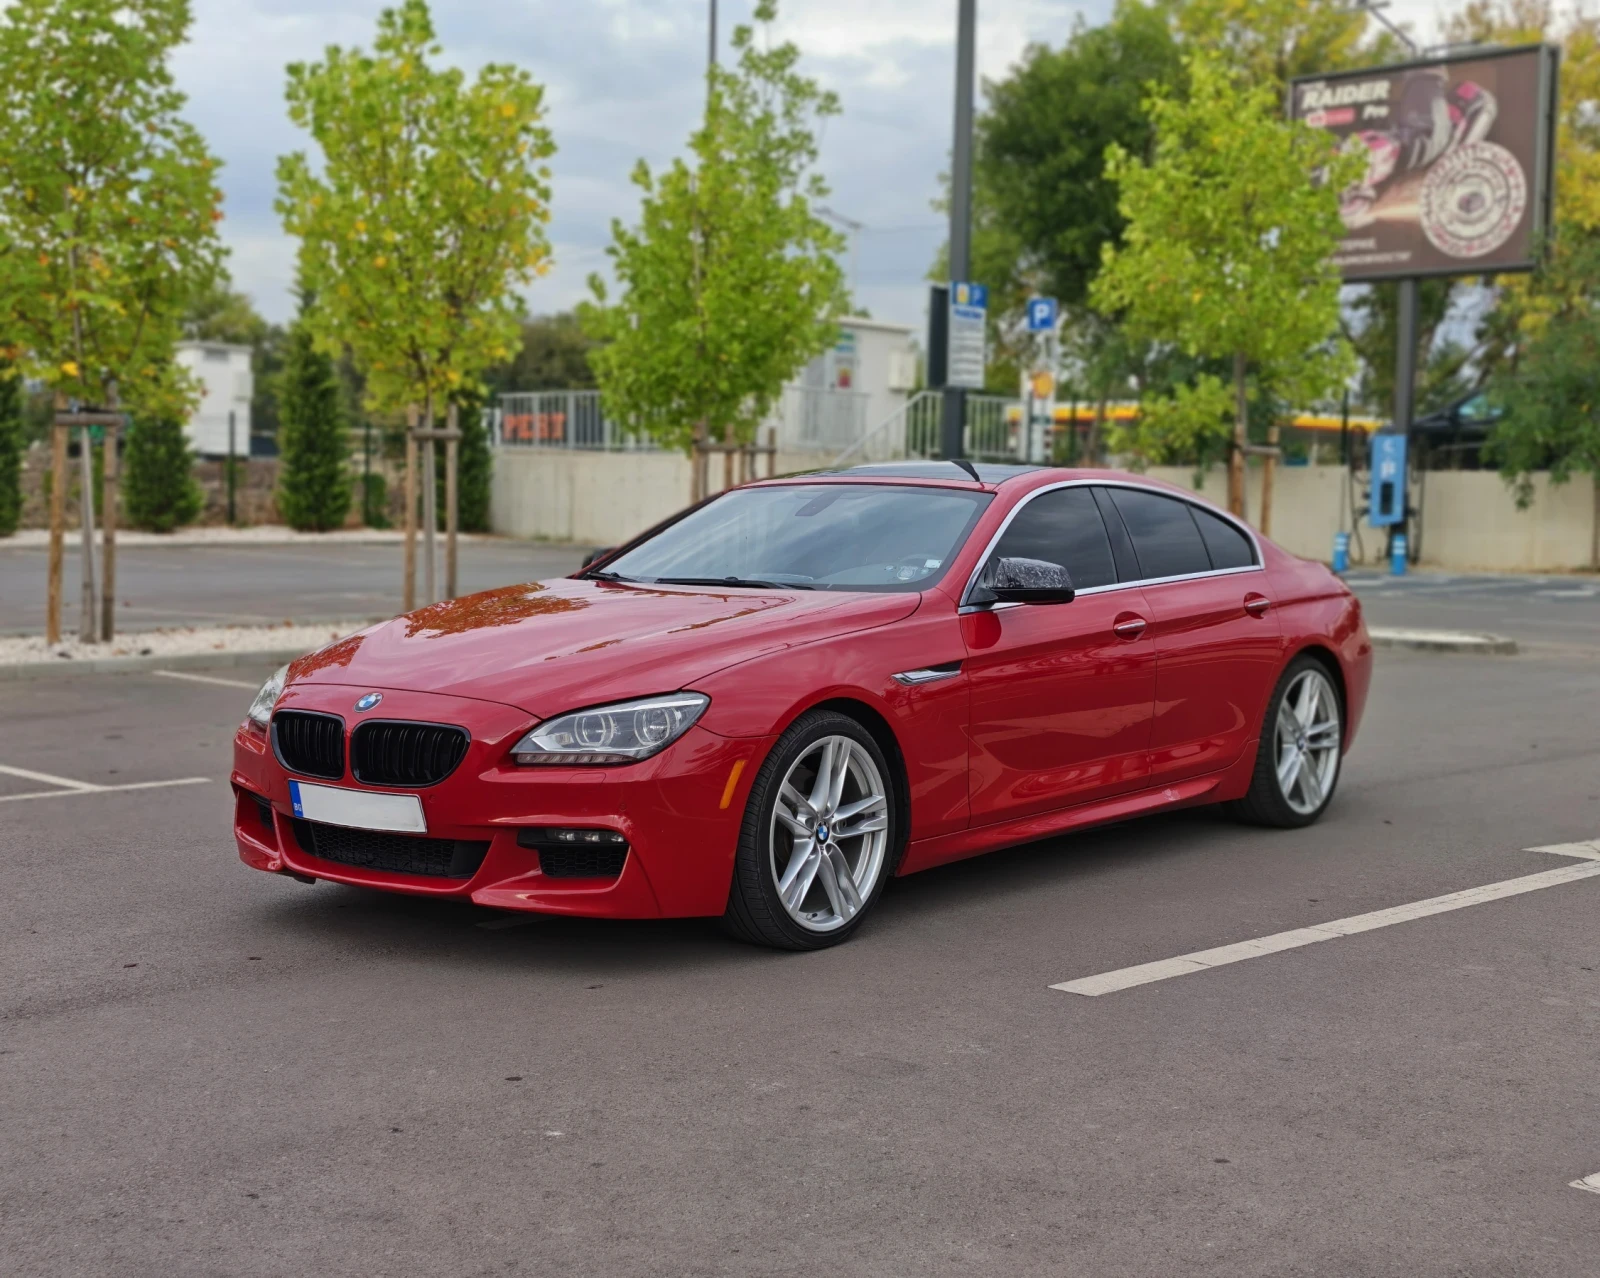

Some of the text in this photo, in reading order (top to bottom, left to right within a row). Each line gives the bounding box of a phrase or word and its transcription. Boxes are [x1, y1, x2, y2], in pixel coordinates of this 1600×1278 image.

[1301, 80, 1390, 110] RAIDER
[1033, 303, 1050, 327] P
[293, 802, 302, 812] BG
